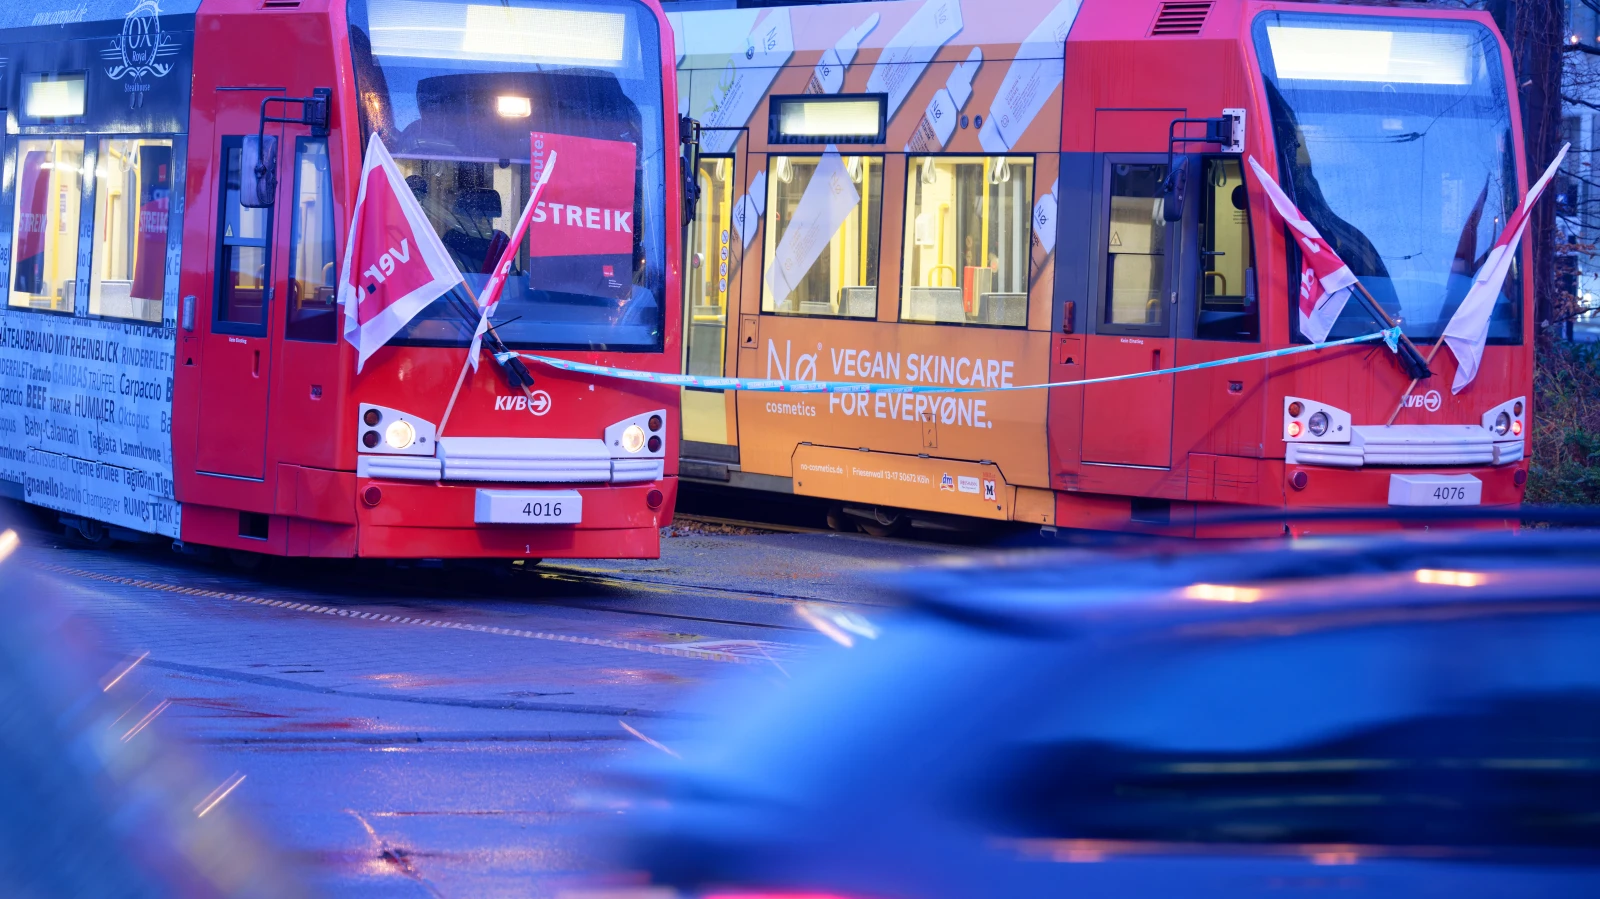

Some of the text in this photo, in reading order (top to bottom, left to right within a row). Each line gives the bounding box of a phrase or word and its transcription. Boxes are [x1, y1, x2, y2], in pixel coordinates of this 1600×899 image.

[128, 16, 152, 48] OX
[132, 50, 146, 64] Royal
[124, 82, 150, 92] Steakhouse
[532, 202, 632, 233] STREIK
[54, 334, 70, 356] MIT
[70, 336, 119, 364] RHEINBLICK
[122, 346, 169, 372] RINDERFILET
[830, 348, 1014, 388] VEGAN SKINCARE
[30, 364, 52, 382] Tartufo
[52, 362, 88, 388] GAMBAS
[88, 369, 116, 394] TRÜFFEL
[120, 373, 162, 403] Carpaccio
[26, 384, 47, 410] BEEF
[50, 397, 72, 415] TARTAR
[74, 394, 115, 423] HUMMER
[118, 406, 150, 433] Oktopus
[494, 394, 528, 410] KVB
[766, 401, 816, 417] cosmetics
[830, 392, 992, 429] FOR EVERYØNE.
[24, 415, 80, 445] Baby-Calamari
[120, 438, 161, 462] Lammkrone
[800, 464, 930, 484] no-cosmetics.de Friesenwall 13-17 50672 Köln
[942, 474, 952, 484] dm
[986, 484, 994, 496] M
[1433, 486, 1465, 500] 4076
[60, 482, 81, 502] Barolo
[124, 496, 173, 524] RUMPSTEAK
[522, 502, 562, 517] 4016
[525, 544, 530, 554] 1
